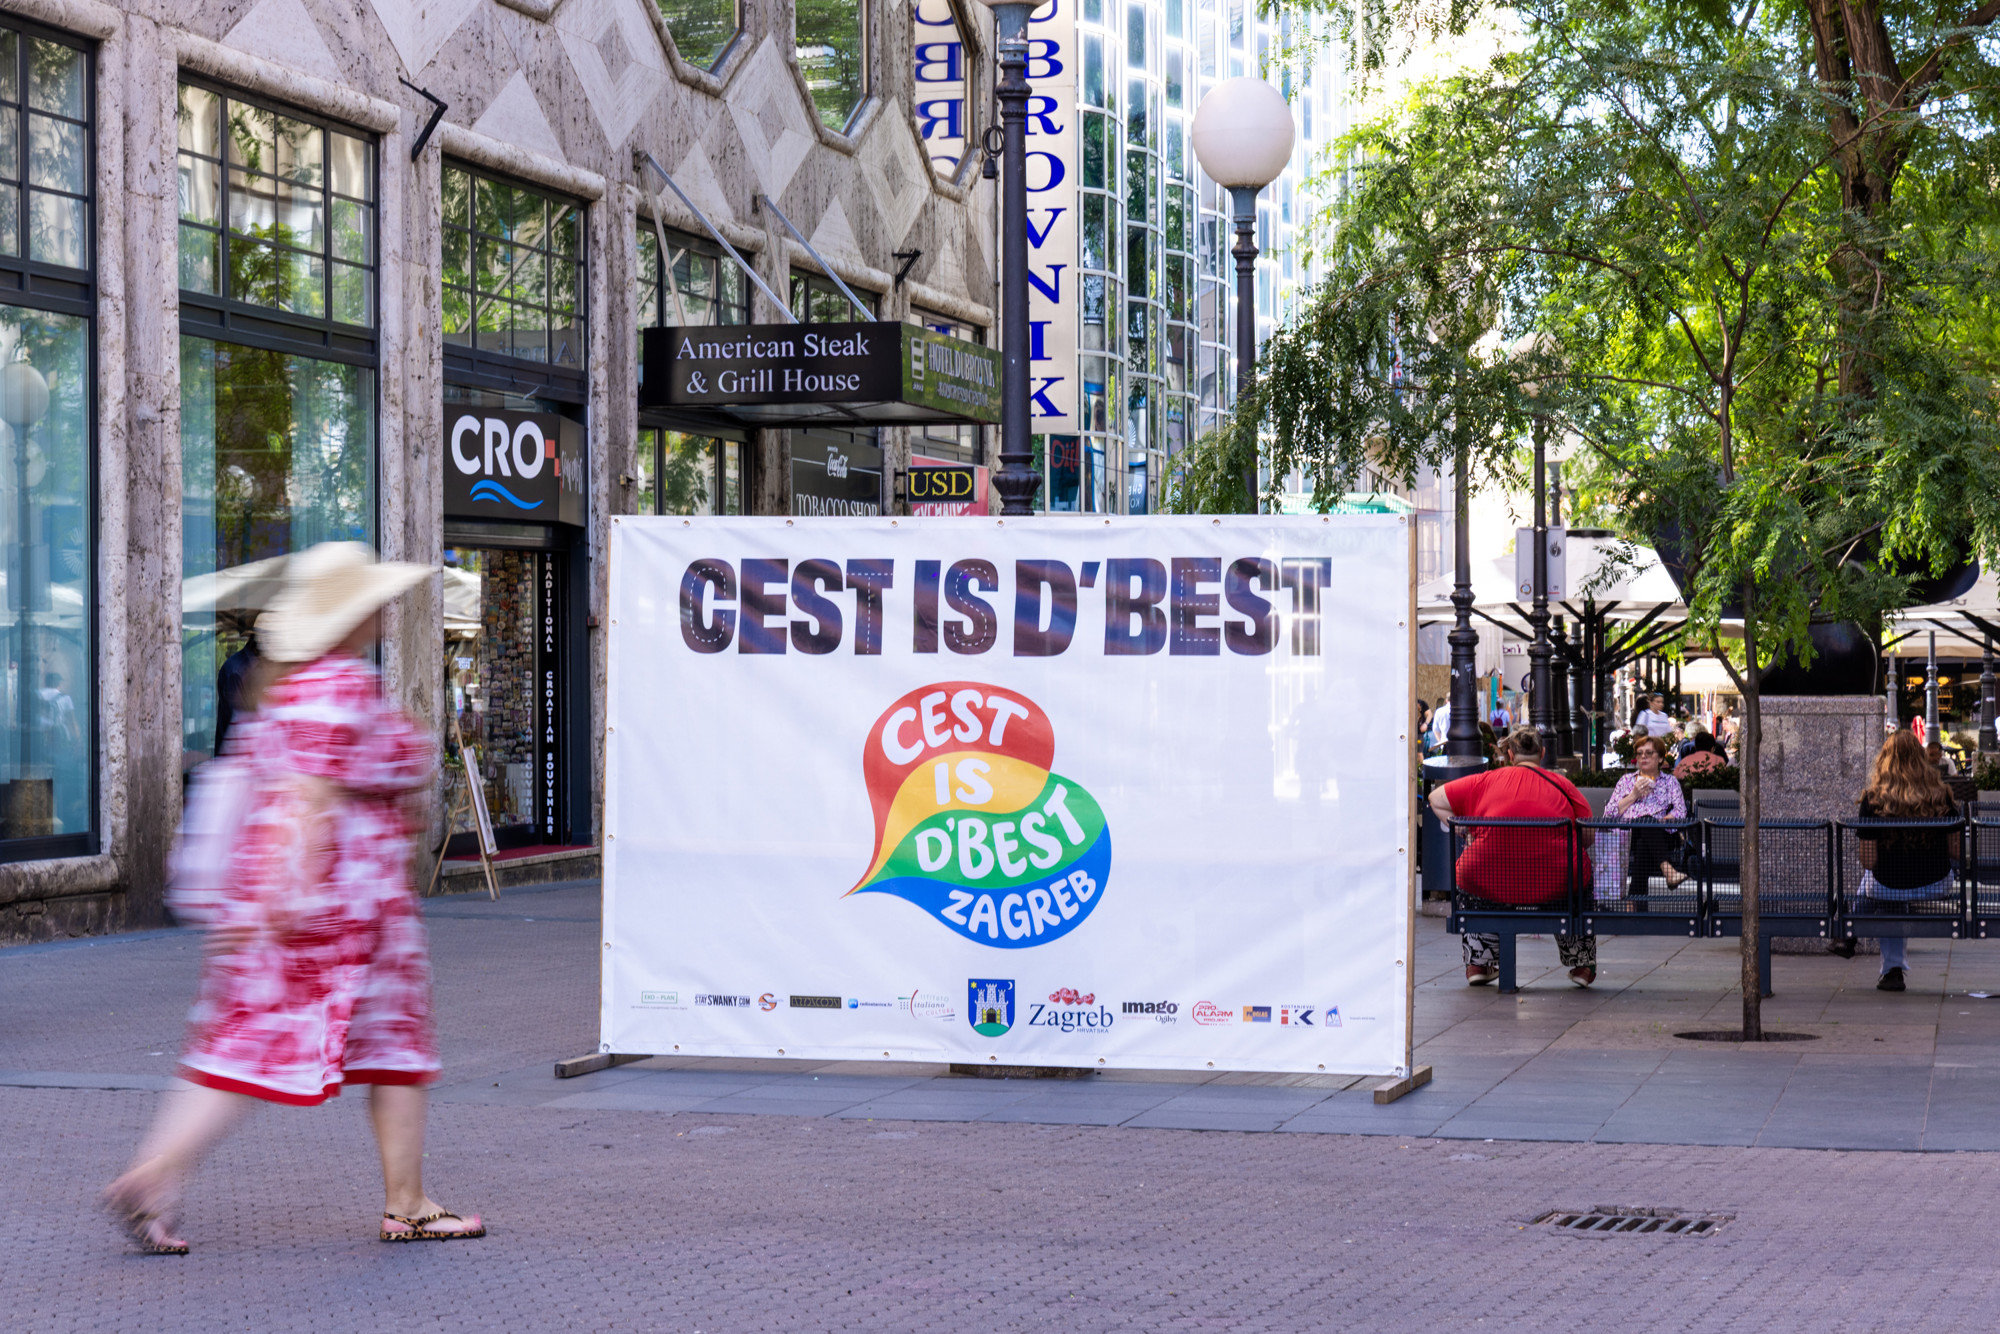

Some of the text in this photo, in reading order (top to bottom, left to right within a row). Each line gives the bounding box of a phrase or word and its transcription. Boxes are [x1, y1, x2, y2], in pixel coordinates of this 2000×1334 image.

[676, 332, 870, 359] American Steak
[928, 342, 954, 376] HOTEL
[686, 368, 860, 393] & Grill House
[451, 414, 545, 479] CRO
[796, 493, 878, 516] TOBACCO SHOP
[908, 472, 973, 497] USD
[679, 556, 1332, 657] CEST IS D'BEST
[545, 553, 554, 834] TRADITIONAL CROATIAN SOUVENIRS
[881, 689, 1028, 765] CEST
[934, 758, 994, 805] IS
[915, 783, 1086, 879] D'BEST
[941, 869, 1097, 942] ZAGREB
[1028, 1004, 1114, 1033] Zagreb
[1155, 1014, 1177, 1024] Ogilvy
